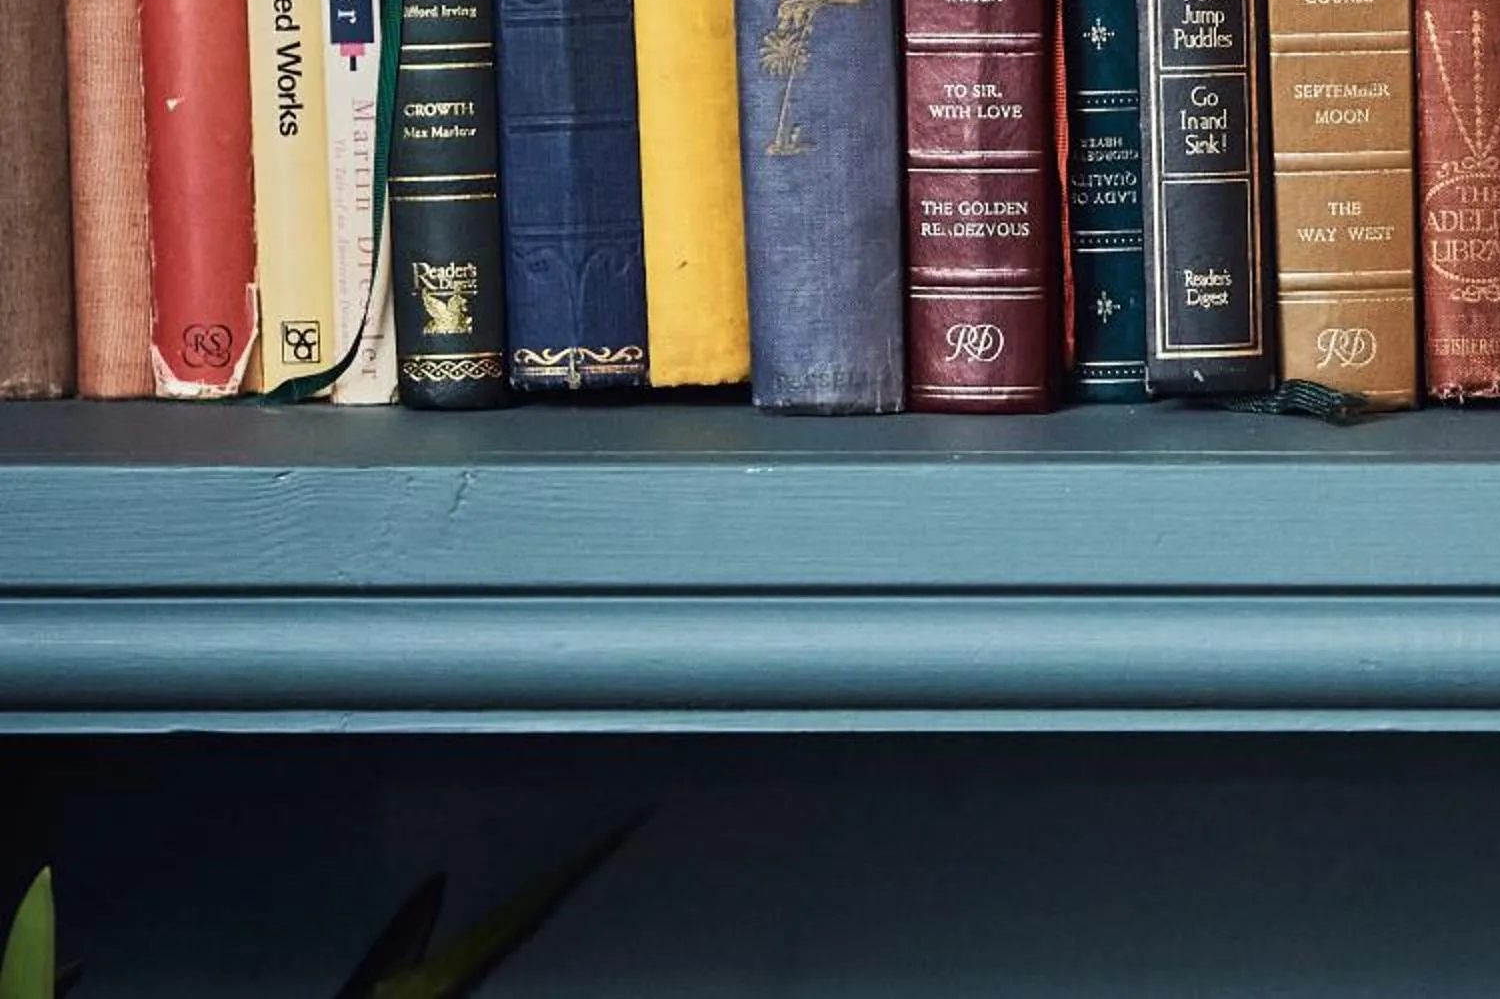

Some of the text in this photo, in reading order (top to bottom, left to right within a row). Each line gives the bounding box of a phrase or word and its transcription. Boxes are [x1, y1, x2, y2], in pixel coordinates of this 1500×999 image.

[1181, 5, 1225, 27] Jump
[1173, 29, 1232, 49] Puddles
[277, 42, 303, 136] Works
[944, 85, 966, 98] TO
[1191, 87, 1218, 105] Go
[405, 103, 474, 115] GROWTH
[929, 105, 1023, 118] WITH LOVE
[1315, 109, 1369, 124] MOON
[1180, 110, 1227, 130] In and
[1186, 136, 1227, 154] Sink!
[922, 201, 1029, 215] THE GOLDEN
[1328, 202, 1361, 216] THE
[1297, 226, 1394, 242] WAY WEST
[1187, 289, 1228, 308] Digest
